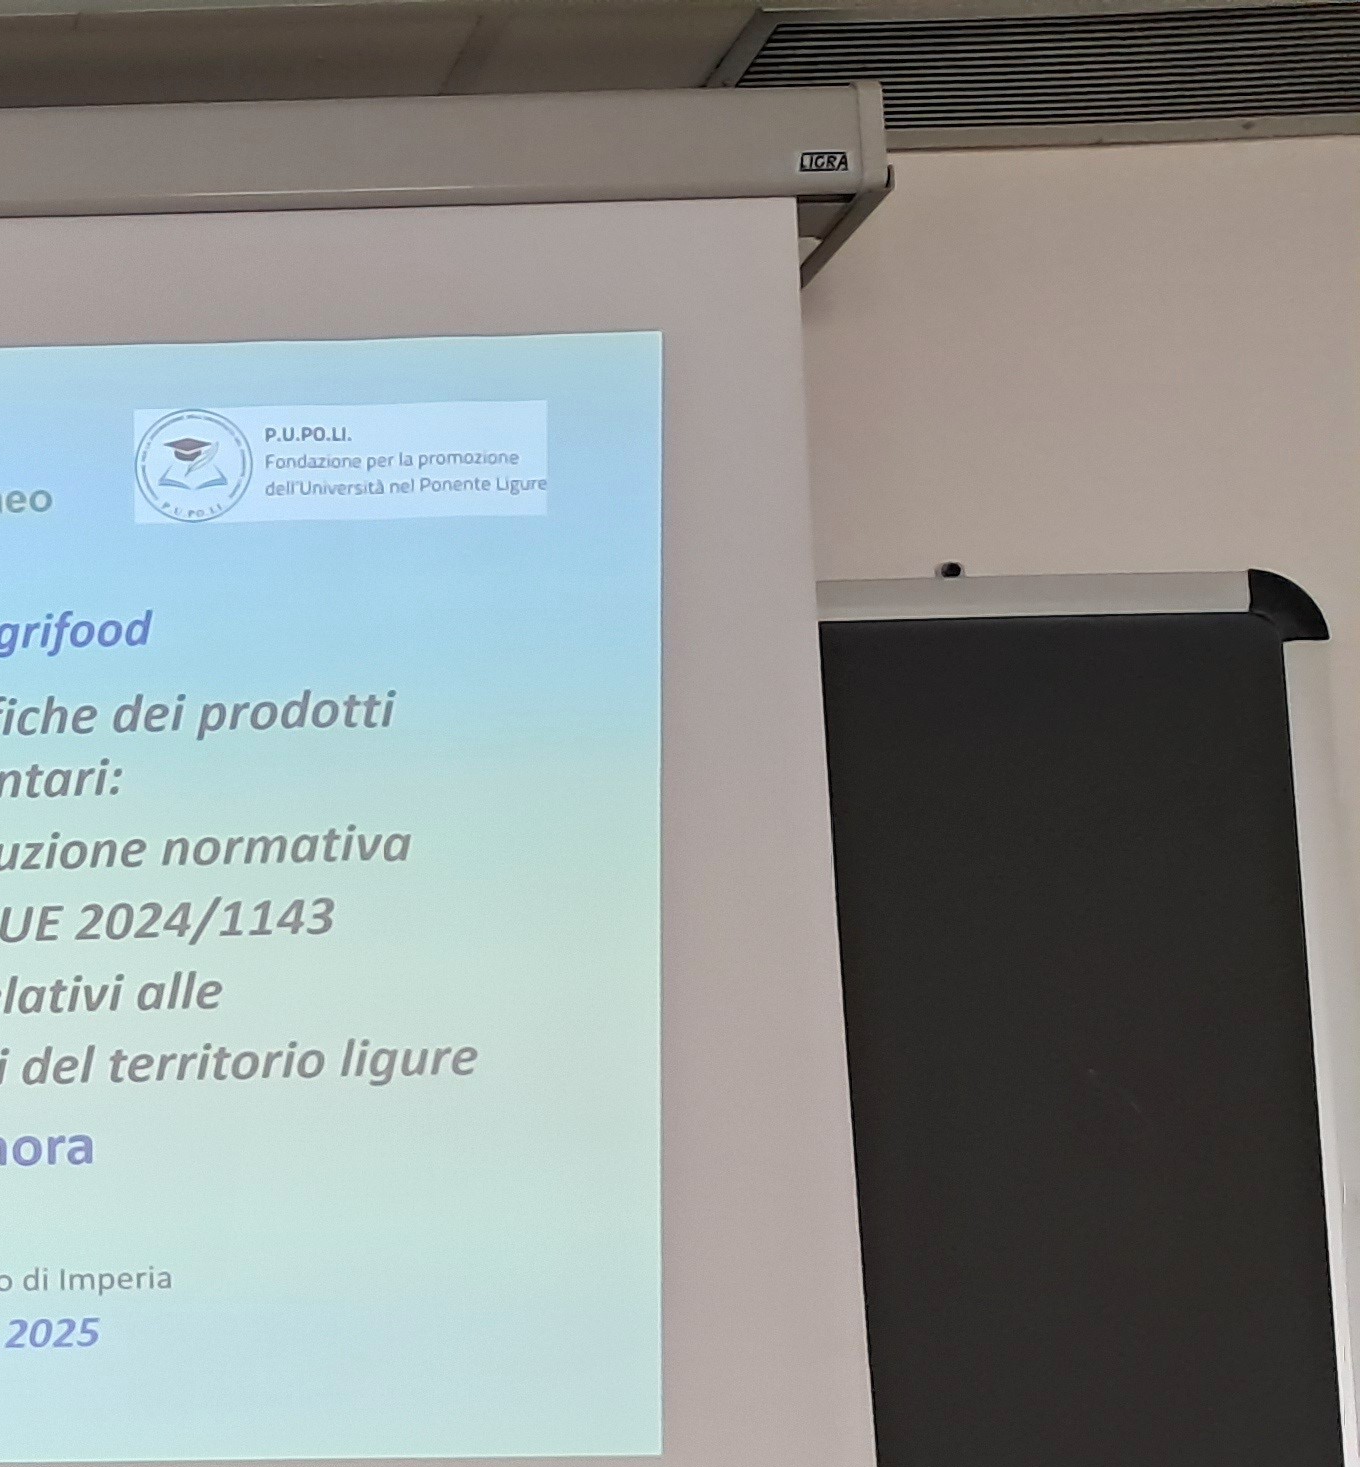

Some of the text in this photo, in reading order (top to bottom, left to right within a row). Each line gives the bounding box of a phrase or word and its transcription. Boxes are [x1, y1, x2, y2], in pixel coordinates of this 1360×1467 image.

[265, 427, 352, 442] P.U.PO.LI.
[112, 693, 186, 732] dei
[196, 690, 397, 741] prodotti
[161, 824, 411, 865] normativa
[75, 896, 335, 945] 2024/1143
[137, 971, 223, 1010] alle
[22, 1045, 96, 1084] del
[109, 1041, 324, 1081] territorio
[340, 1038, 478, 1086] ligure
[23, 1267, 48, 1291] di
[60, 1266, 173, 1295] Imperia
[5, 1317, 100, 1348] 2025
